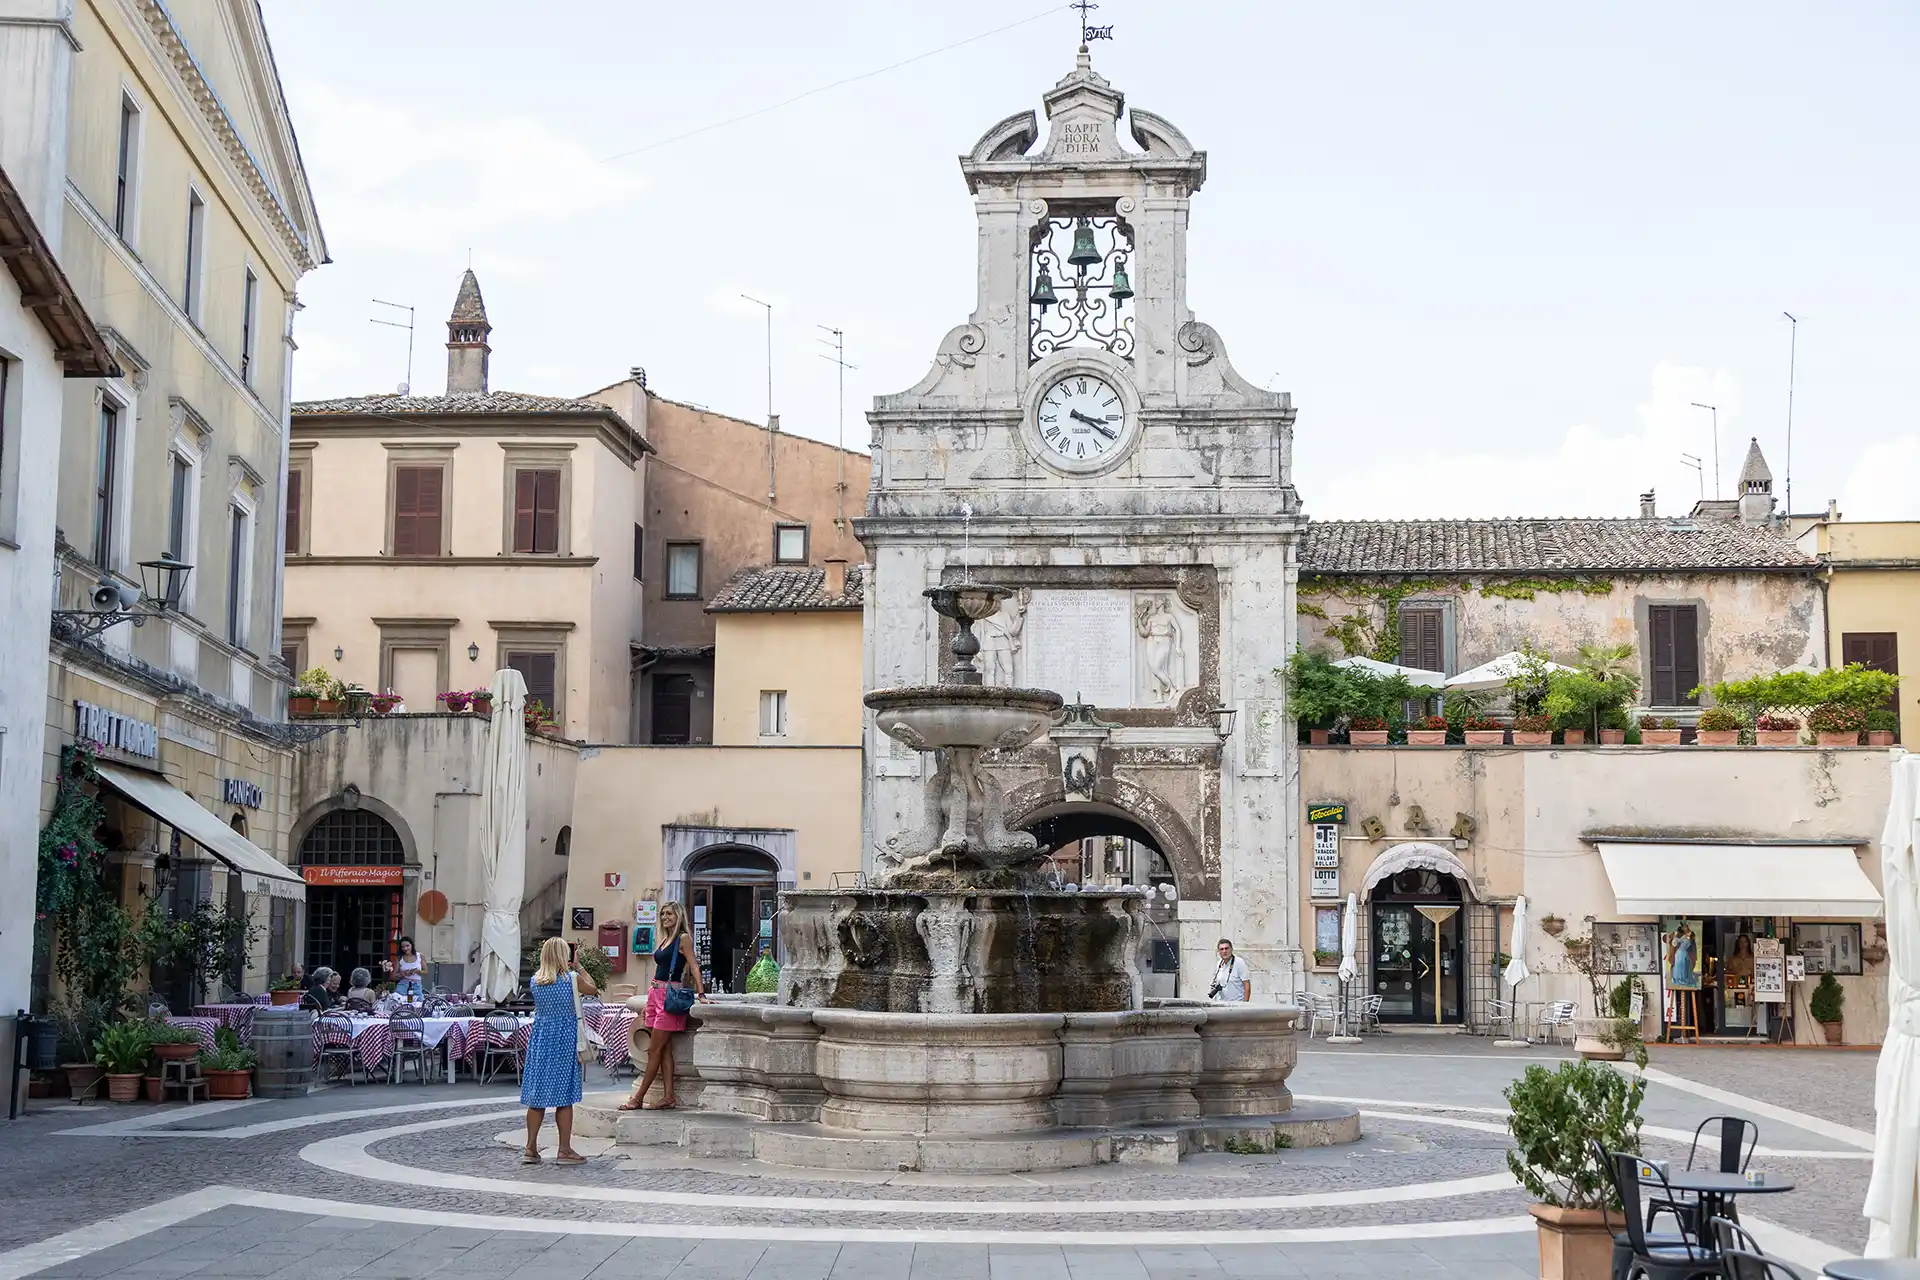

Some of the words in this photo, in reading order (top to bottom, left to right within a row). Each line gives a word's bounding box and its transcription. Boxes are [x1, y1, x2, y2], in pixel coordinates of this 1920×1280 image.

[1065, 124, 1102, 133] RAPIT
[1065, 134, 1101, 143] HORA
[1066, 143, 1099, 153] DIEM
[1060, 385, 1072, 399] XI
[1076, 381, 1087, 394] XII
[1093, 386, 1101, 397] I
[1047, 397, 1061, 409] X
[1101, 398, 1115, 408] II
[74, 700, 159, 759] TRATTORIA
[1310, 805, 1344, 821] Totocalcio
[1317, 825, 1334, 842] T
[320, 868, 329, 877] Il
[329, 868, 368, 878] Pifferaio
[368, 868, 401, 878] Magico
[1314, 870, 1336, 879] LOTTO
